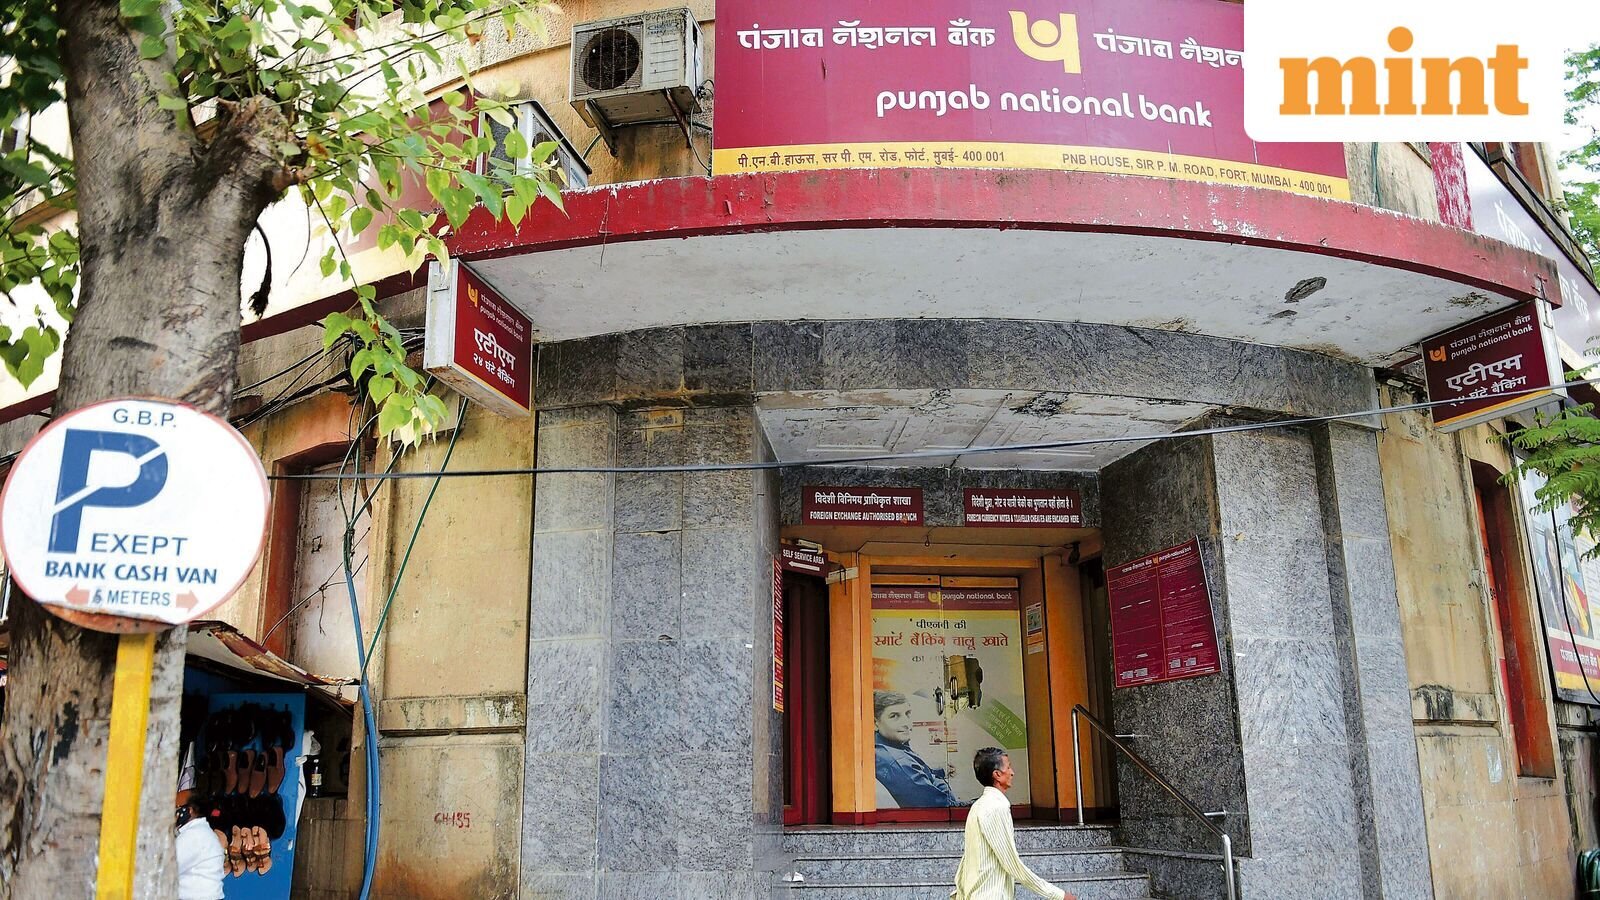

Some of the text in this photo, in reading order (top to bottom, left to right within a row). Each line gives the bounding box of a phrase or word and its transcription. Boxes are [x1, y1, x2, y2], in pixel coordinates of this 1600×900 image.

[736, 23, 824, 50] पंजाब
[1093, 28, 1244, 69] पंजाब नैशन
[876, 84, 1213, 128] punjab national bank
[822, 153, 838, 164] सर
[963, 151, 982, 161] 400
[986, 151, 1005, 162] 001
[1062, 153, 1087, 165] PNB
[1090, 155, 1134, 170] HOUSE,
[1136, 158, 1155, 171] SIR
[1157, 160, 1167, 172] P.
[1169, 161, 1182, 174] M.
[1184, 163, 1218, 179] ROAD,
[1220, 167, 1250, 183] FORT,
[1251, 172, 1292, 188] MUMBAI
[1299, 180, 1316, 193] 400
[1317, 182, 1333, 195] 001
[474, 327, 516, 371] एटीएम
[1450, 324, 1534, 360] punjab national bank
[1446, 354, 1523, 392] एटीएम
[113, 408, 177, 428] G.B.P.
[810, 511, 833, 520] FOREIGN
[834, 511, 861, 520] EXCHANGE
[862, 512, 895, 521] AUTHORISED
[90, 532, 189, 556] EXEPT
[783, 549, 825, 565] SELF SERVICE AREA
[45, 560, 217, 585] BANK CASH VAN
[107, 590, 171, 607] METERS
[942, 592, 965, 600] punjab
